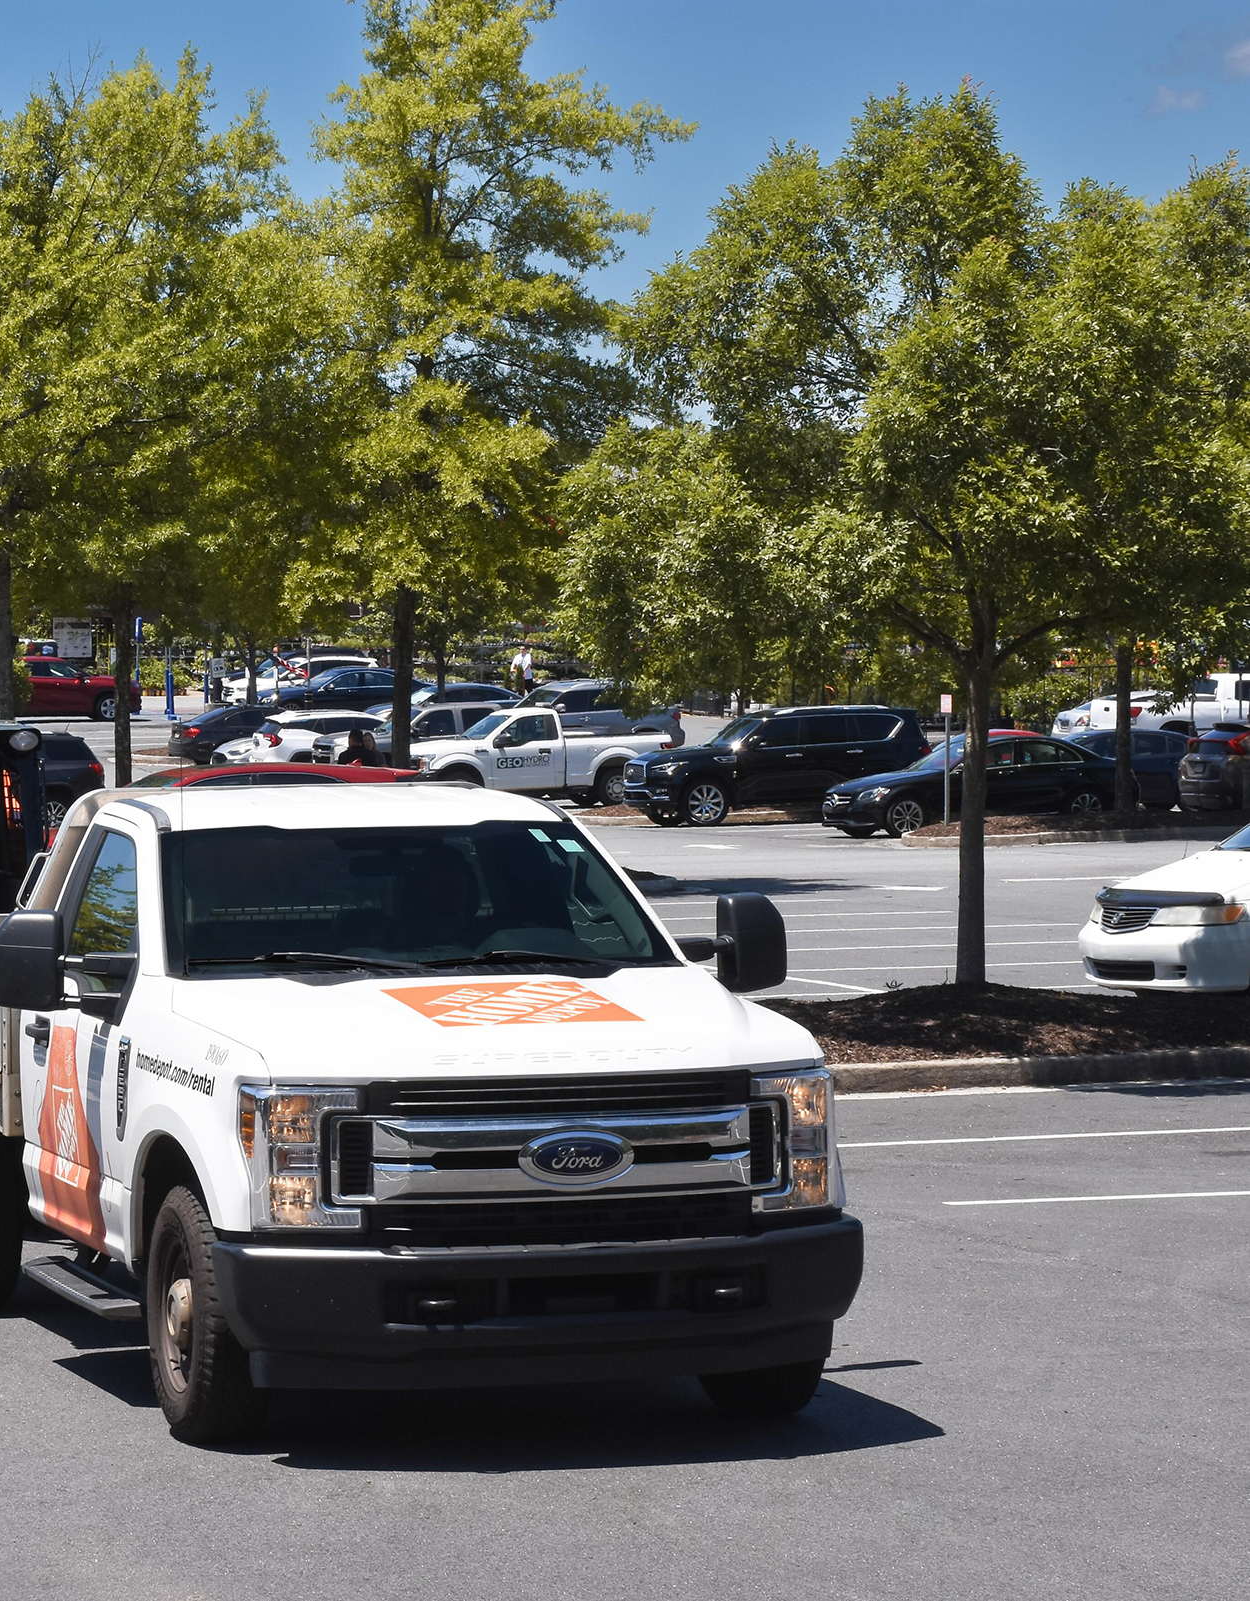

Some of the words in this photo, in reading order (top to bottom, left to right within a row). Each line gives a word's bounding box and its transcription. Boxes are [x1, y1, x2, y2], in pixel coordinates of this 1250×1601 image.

[498, 758, 522, 768] GEO
[522, 755, 550, 763] HYDRO
[424, 987, 496, 1008] THE
[430, 980, 591, 1026] HOME
[516, 995, 613, 1024] DEPOT
[433, 1051, 579, 1066] SUPER
[587, 1046, 693, 1062] DUTY
[135, 1047, 216, 1098] homedepot.com/rental
[551, 1145, 604, 1170] Ford
